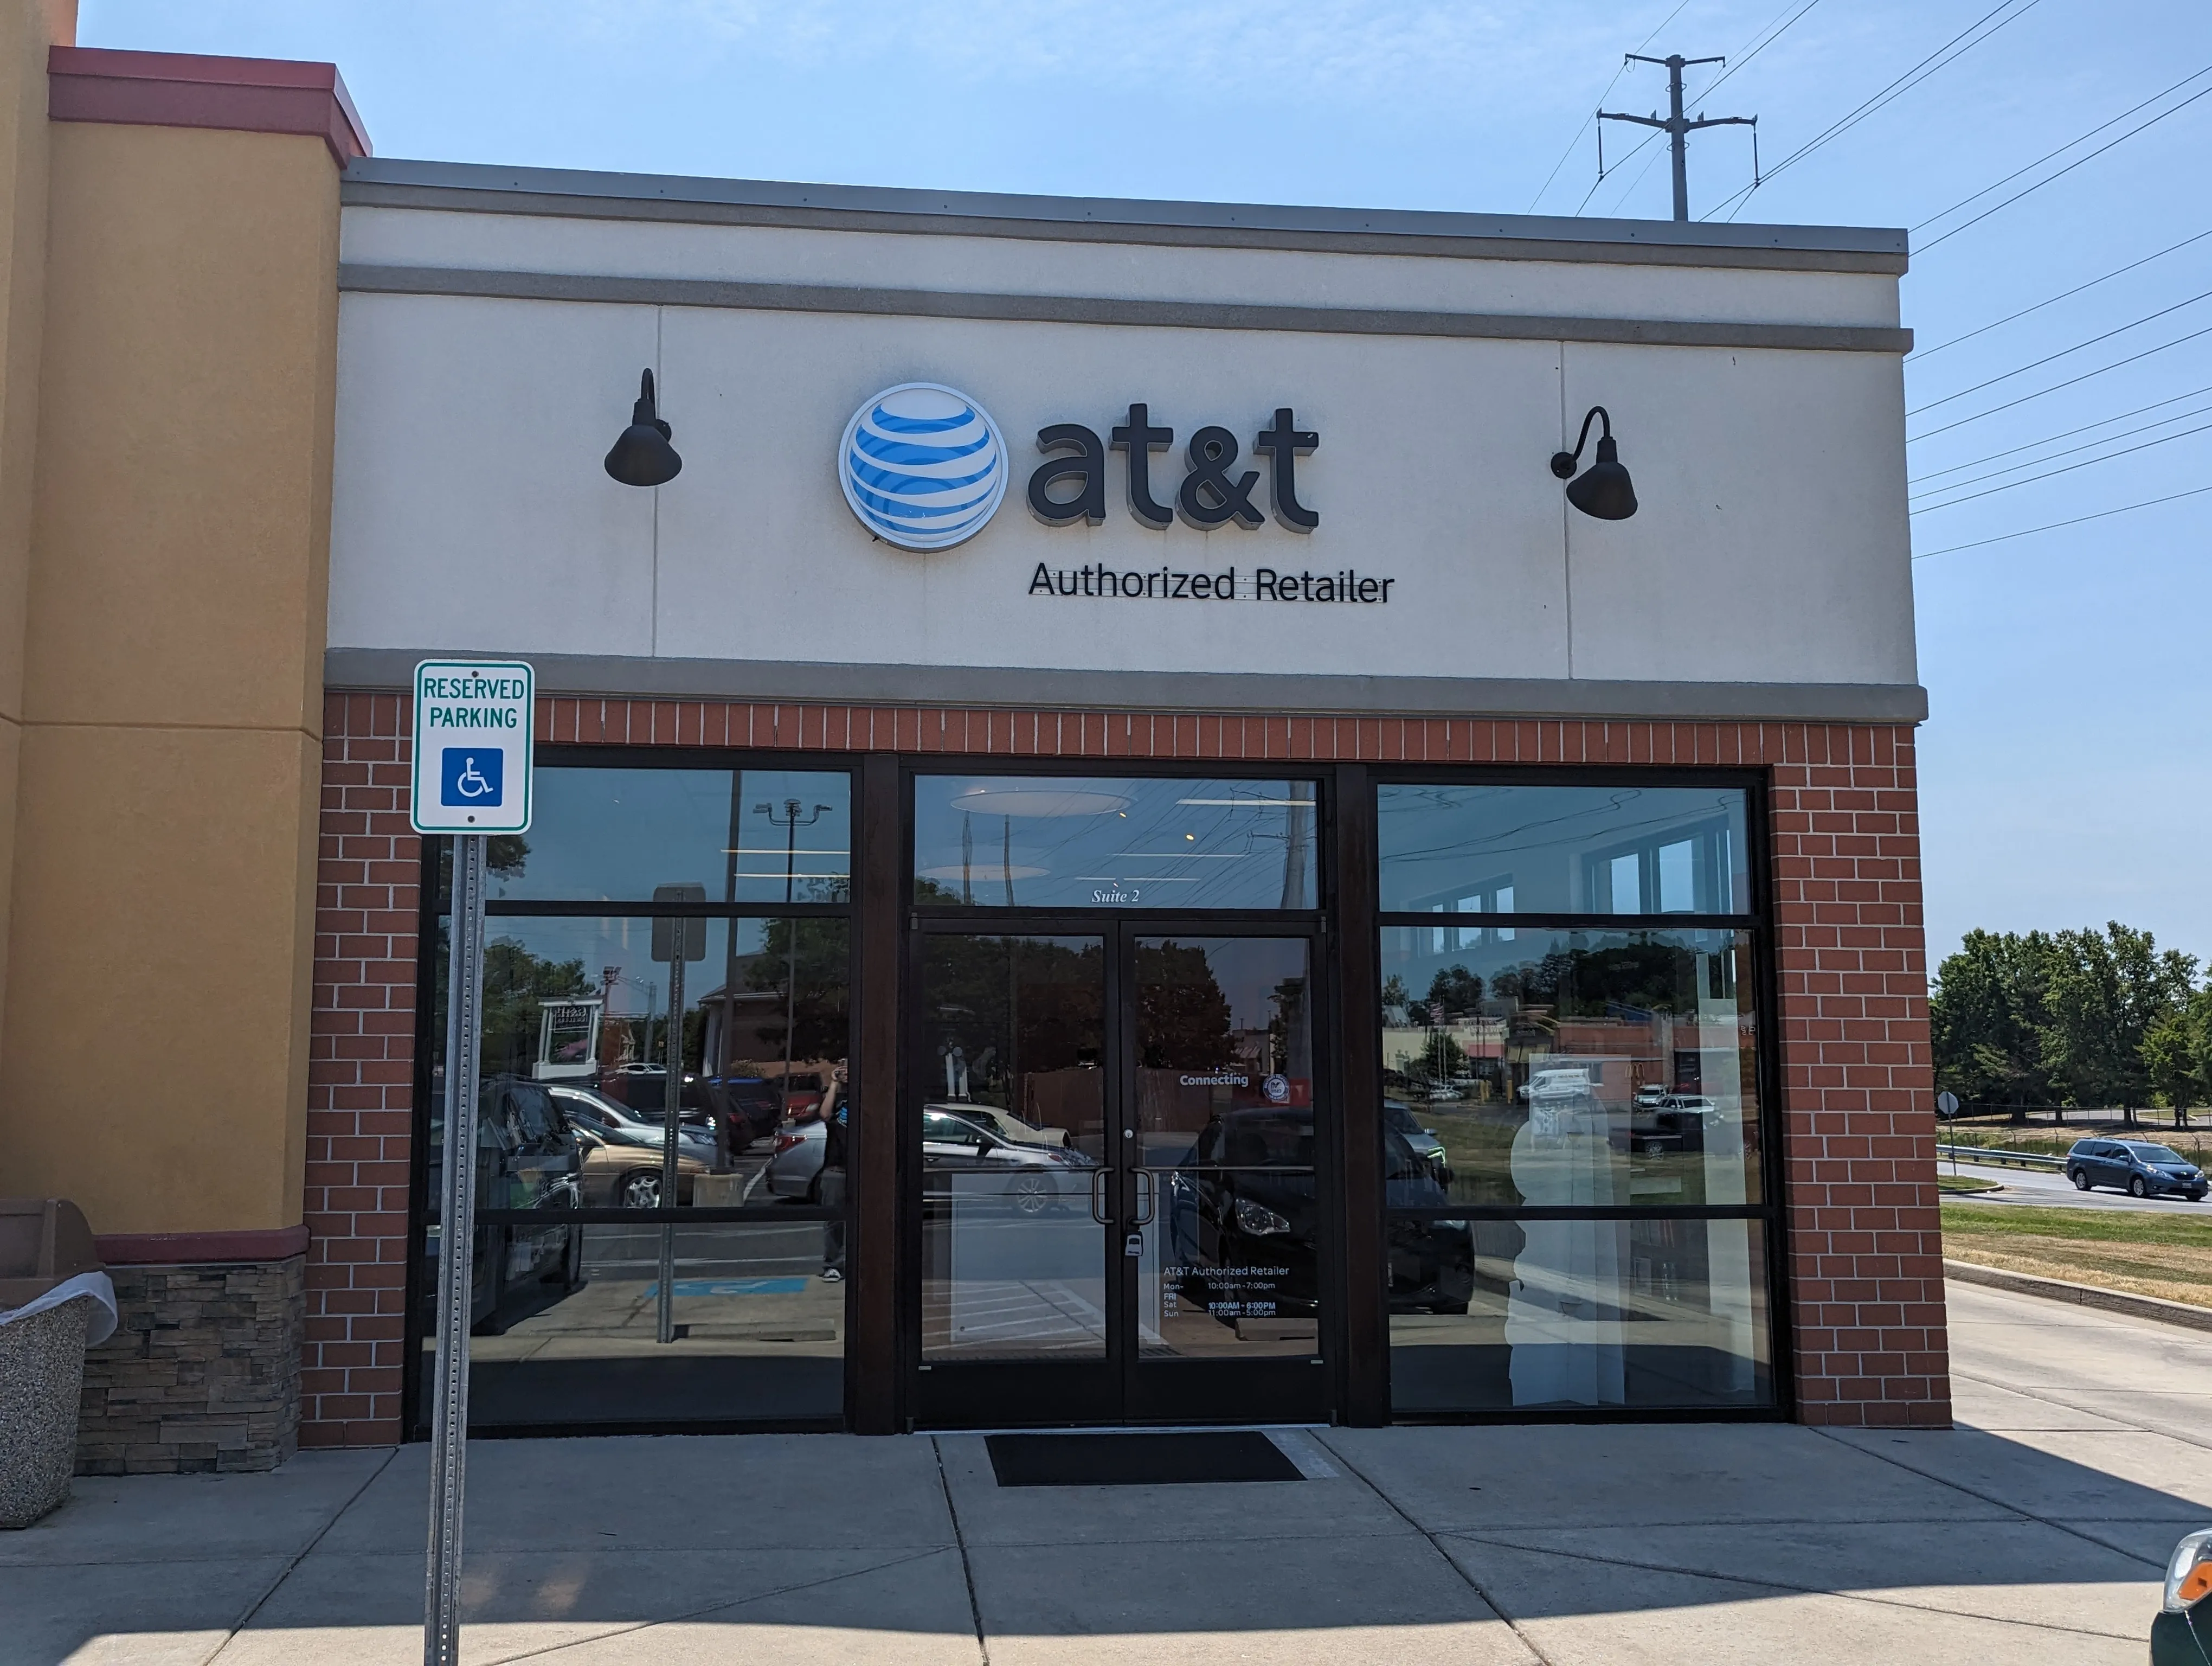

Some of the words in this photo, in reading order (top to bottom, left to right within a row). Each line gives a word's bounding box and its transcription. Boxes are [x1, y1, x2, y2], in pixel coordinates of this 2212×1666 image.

[1026, 403, 1319, 534] at&t
[1028, 562, 1236, 600] Authorized
[1256, 568, 1394, 604] Retailer
[424, 678, 524, 699] RESERVED
[430, 707, 517, 728] PARKING
[1091, 889, 1128, 902] Suite
[1131, 889, 1140, 902] 2
[1179, 1074, 1249, 1087] Connecting
[1163, 1266, 1189, 1276] AT&T
[1192, 1266, 1248, 1276] Authorized
[1250, 1266, 1290, 1276] Retailer
[1247, 1282, 1276, 1291] 7:00pm
